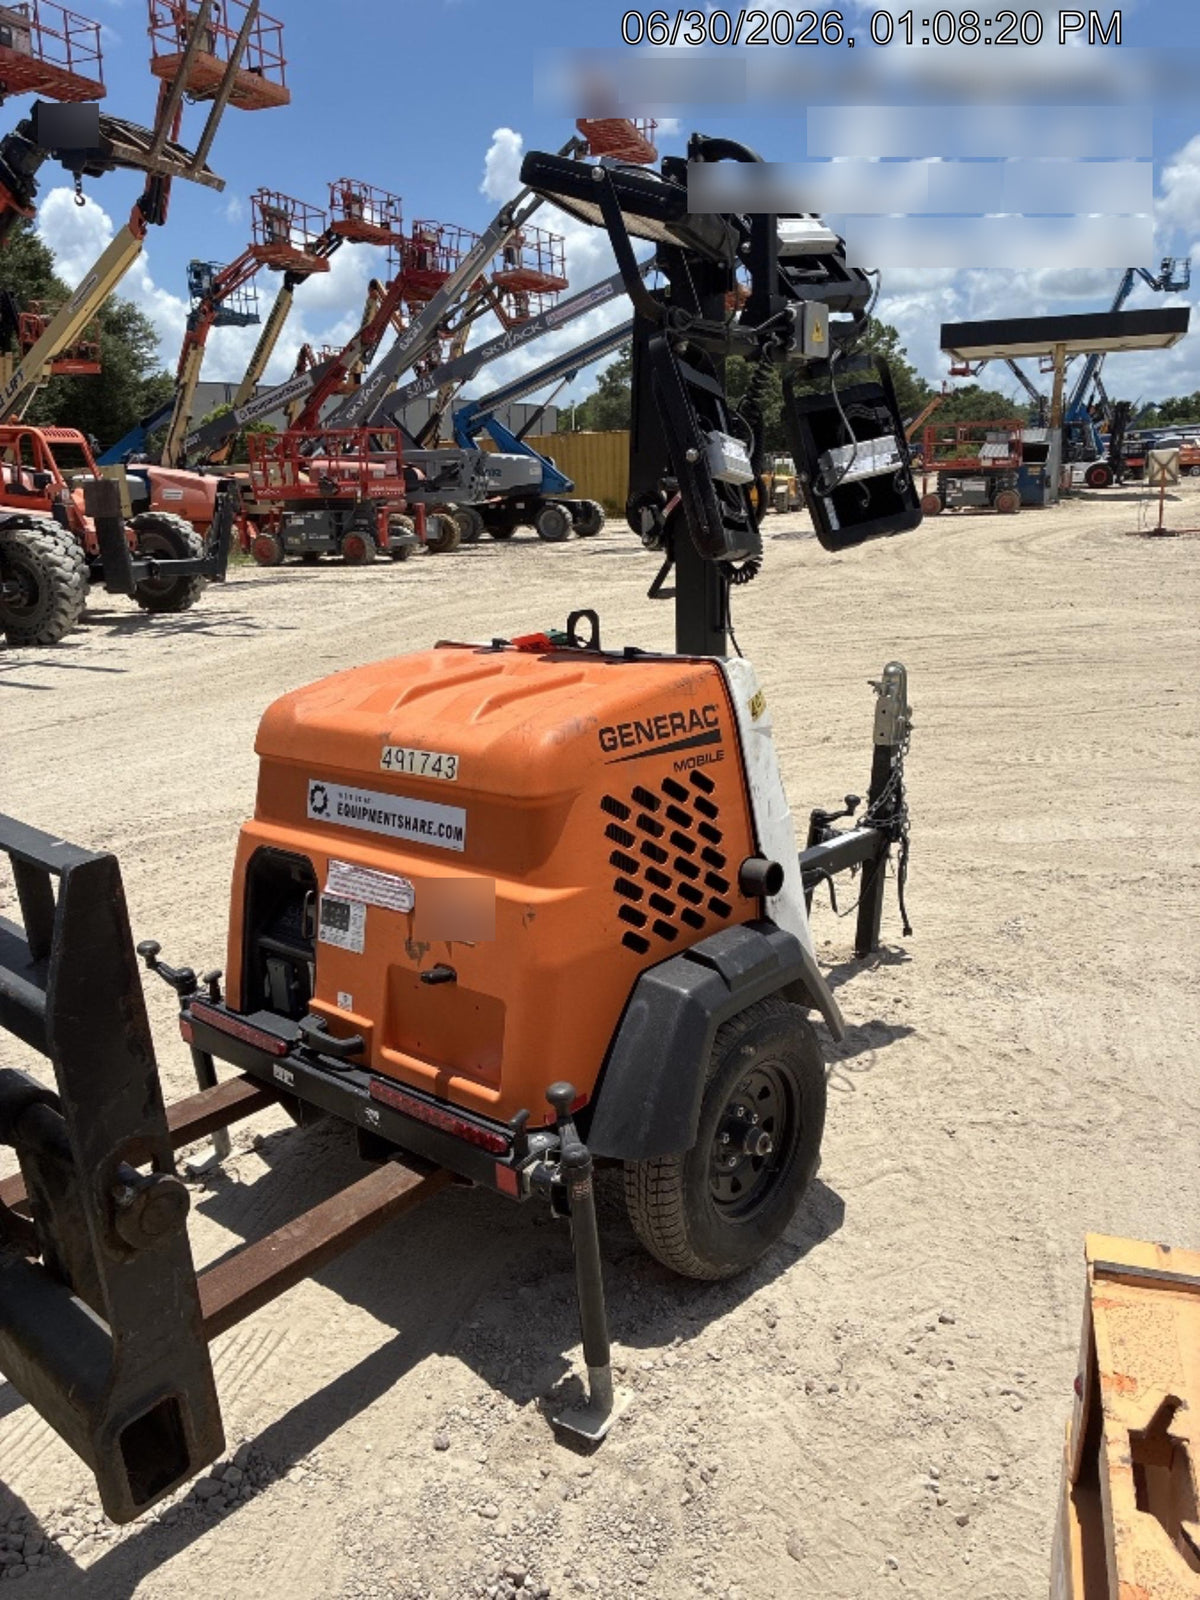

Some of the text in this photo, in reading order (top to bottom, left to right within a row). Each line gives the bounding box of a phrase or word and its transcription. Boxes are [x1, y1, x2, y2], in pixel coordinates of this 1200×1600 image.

[481, 320, 544, 359] SKYJACK
[598, 703, 719, 753] GENERAC
[381, 747, 457, 780] 491743
[672, 750, 725, 773] MOBILE
[336, 802, 464, 842] EQUIPMENTSHARE.COM
